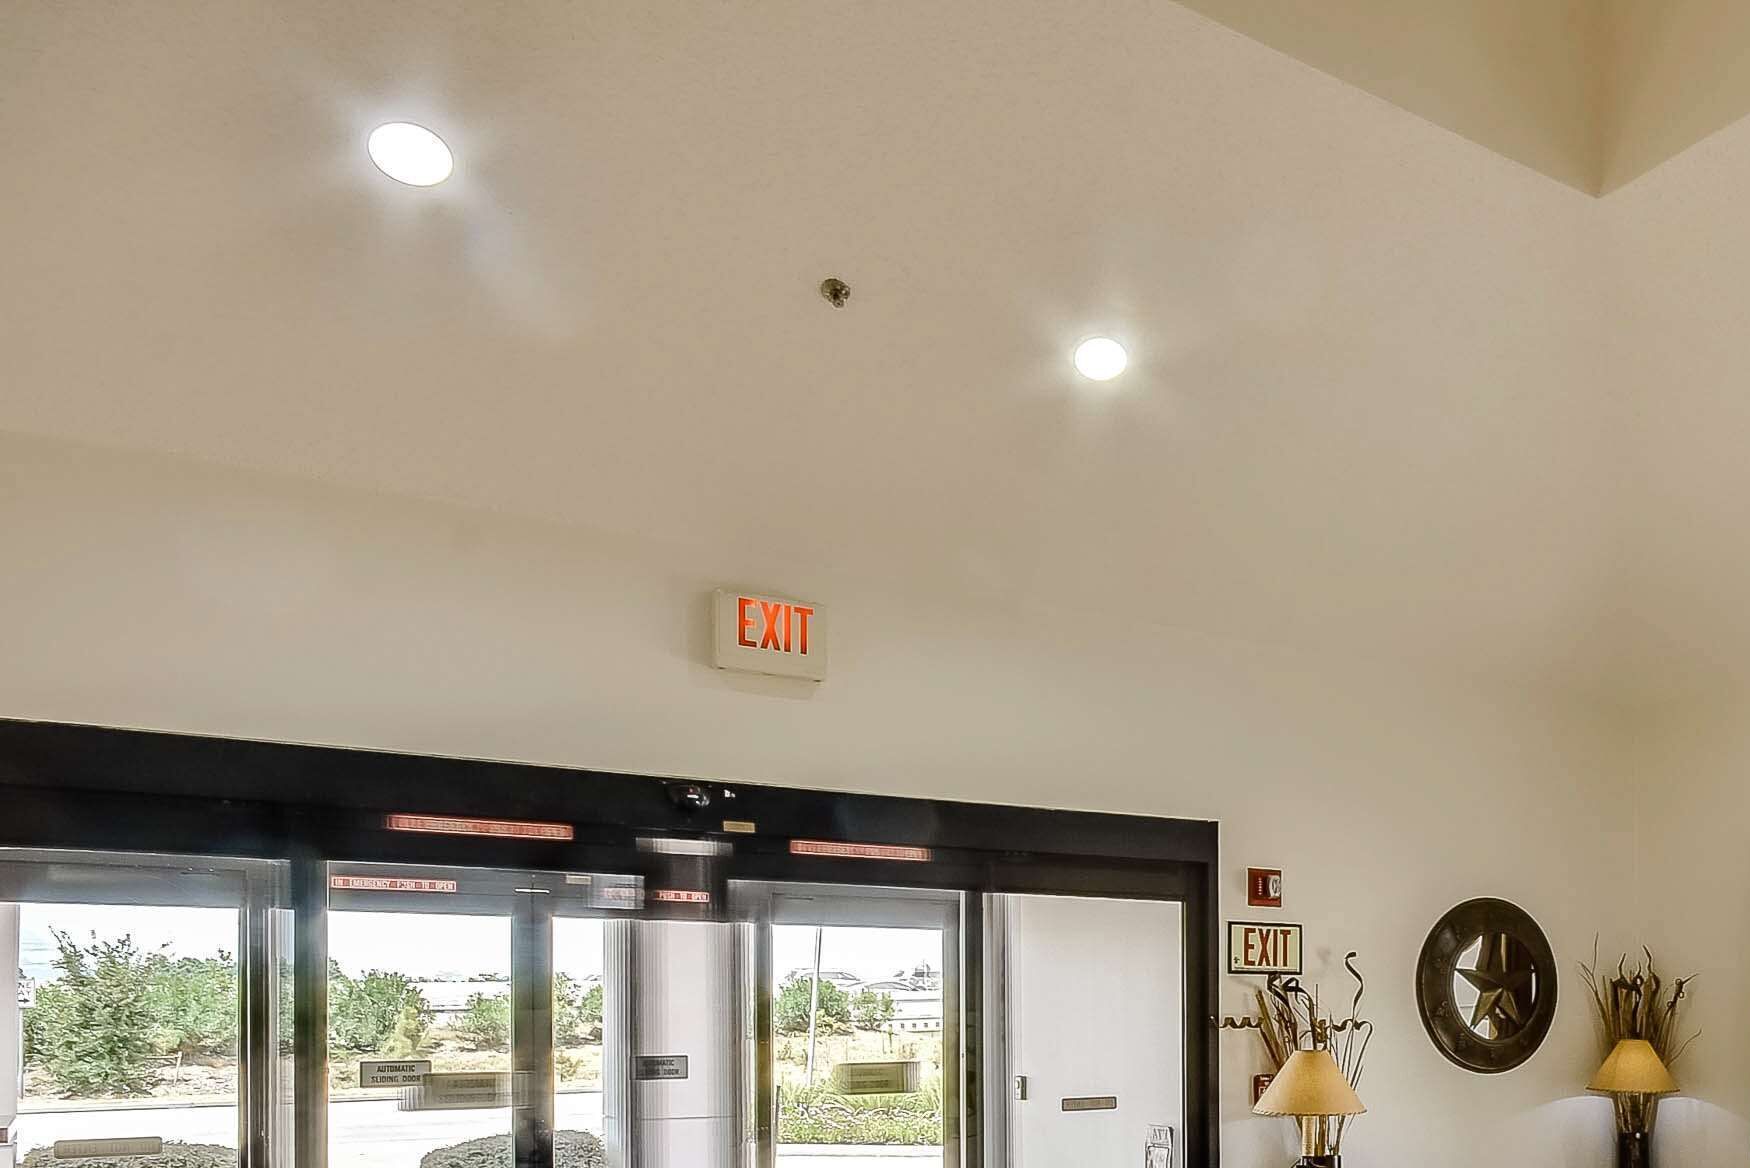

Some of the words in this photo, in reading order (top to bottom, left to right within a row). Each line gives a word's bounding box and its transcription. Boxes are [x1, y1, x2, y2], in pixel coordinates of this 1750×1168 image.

[738, 597, 814, 655] EXIT
[351, 879, 389, 889] EMERGENCY
[436, 881, 454, 891] OPEN
[1244, 927, 1291, 967] EXIT
[376, 1064, 416, 1073] AUTOMATIC
[371, 1075, 399, 1083] SLIDING
[402, 1074, 421, 1082] DOOR
